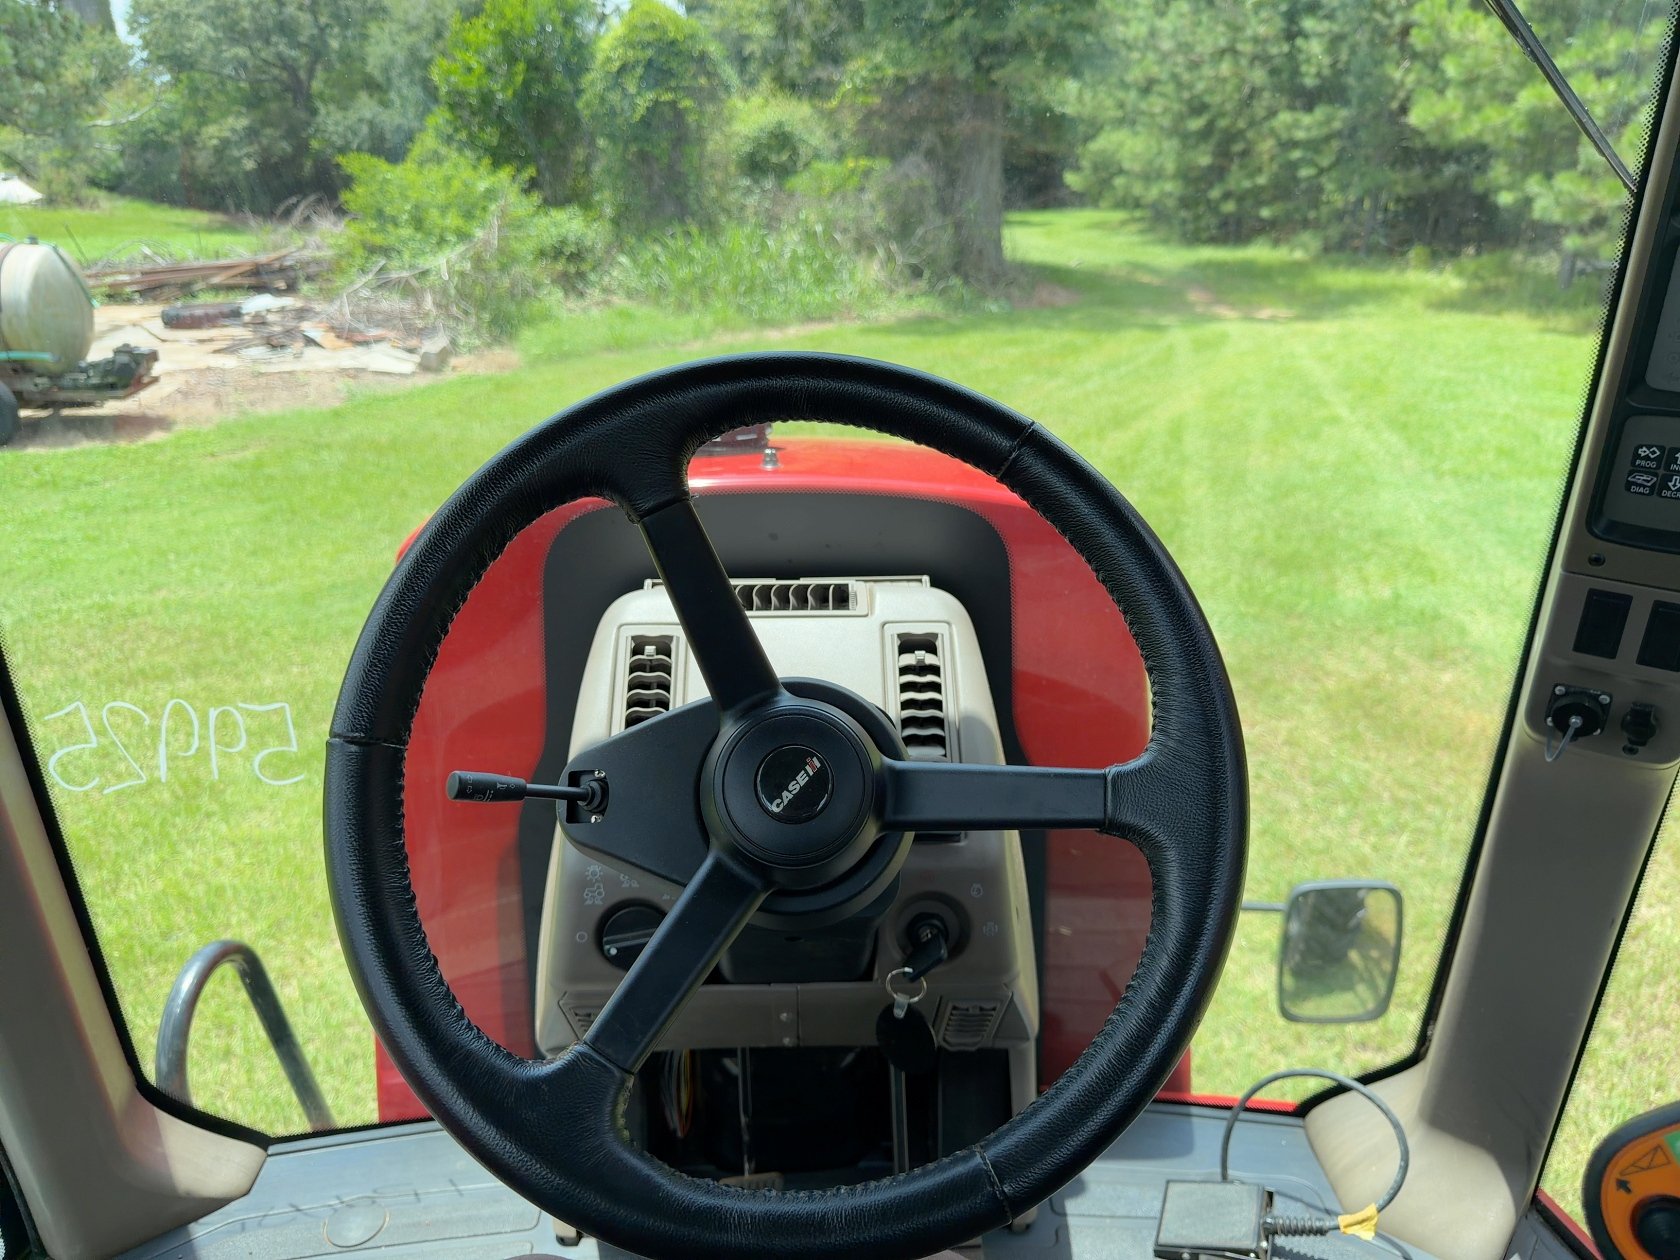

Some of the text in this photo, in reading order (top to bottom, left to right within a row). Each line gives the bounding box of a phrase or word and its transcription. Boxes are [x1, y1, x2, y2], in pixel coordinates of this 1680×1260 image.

[1635, 459, 1657, 468] PROG
[1630, 485, 1650, 494] DIAG
[771, 770, 809, 813] CASE
